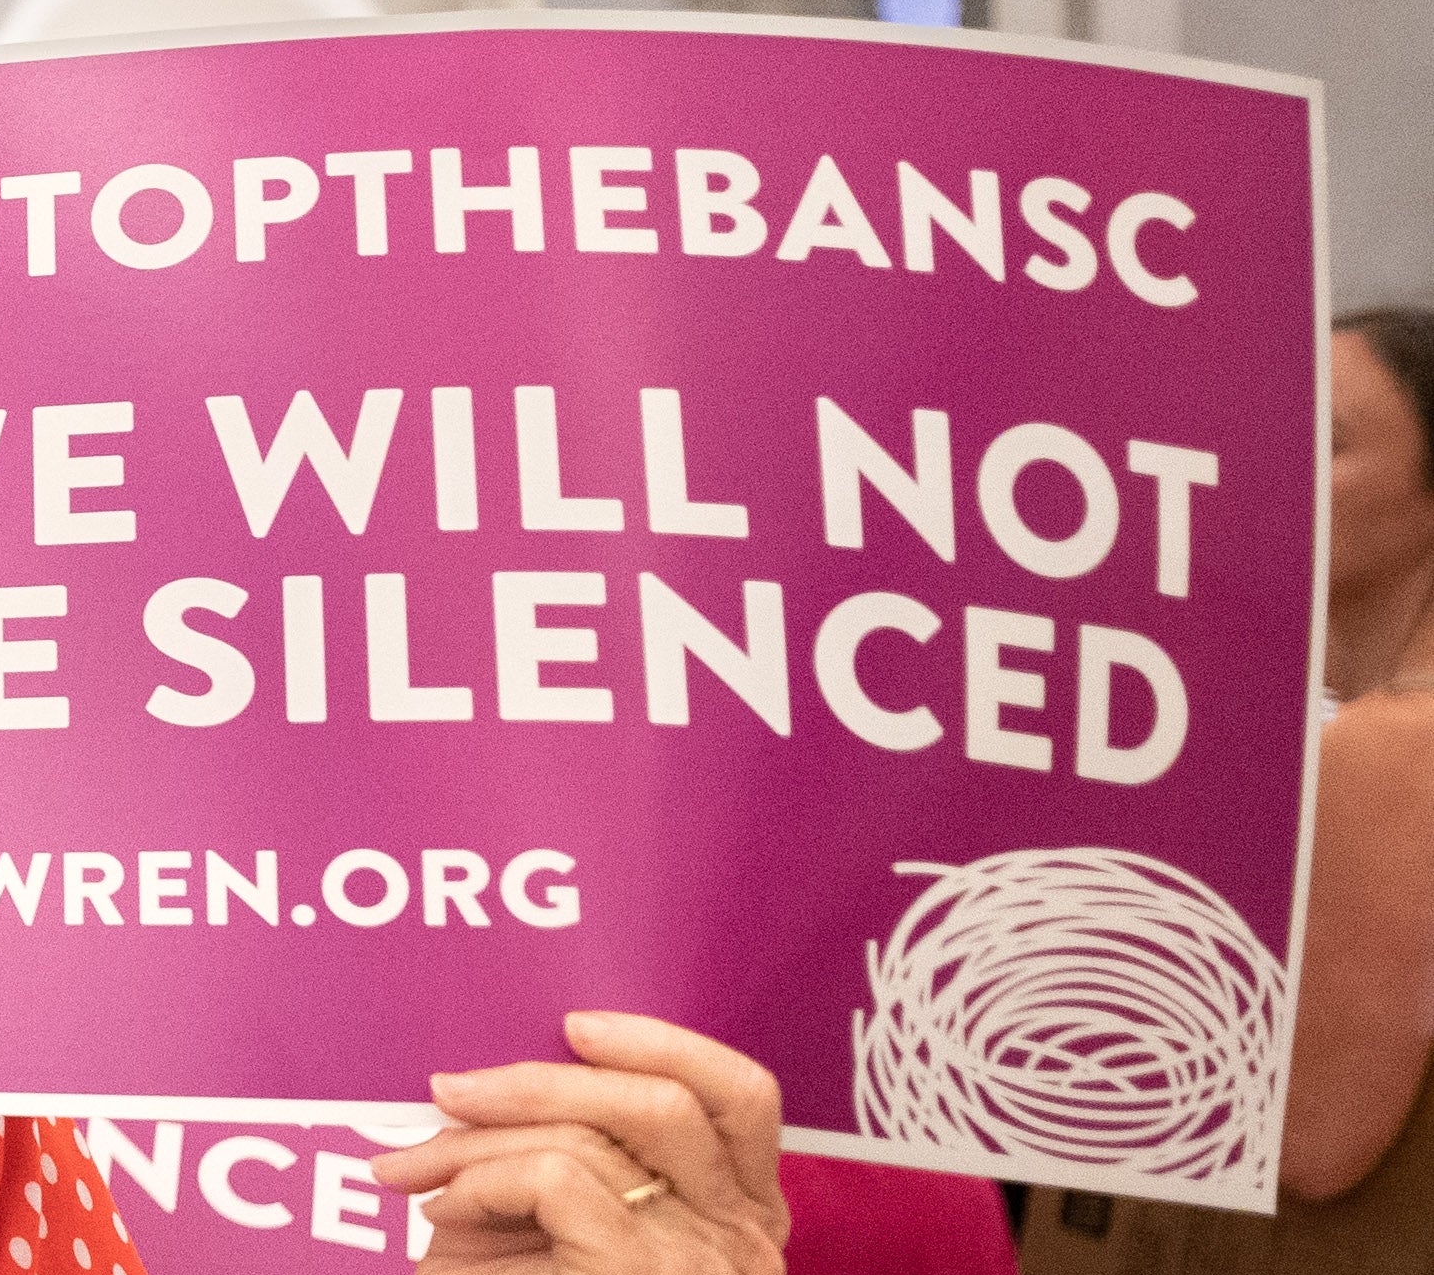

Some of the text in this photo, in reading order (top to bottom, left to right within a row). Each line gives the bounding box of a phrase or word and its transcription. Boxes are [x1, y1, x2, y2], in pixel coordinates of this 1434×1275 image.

[202, 383, 751, 541] WILL
[815, 395, 1219, 598] NOT
[140, 568, 1188, 785] SILENCED
